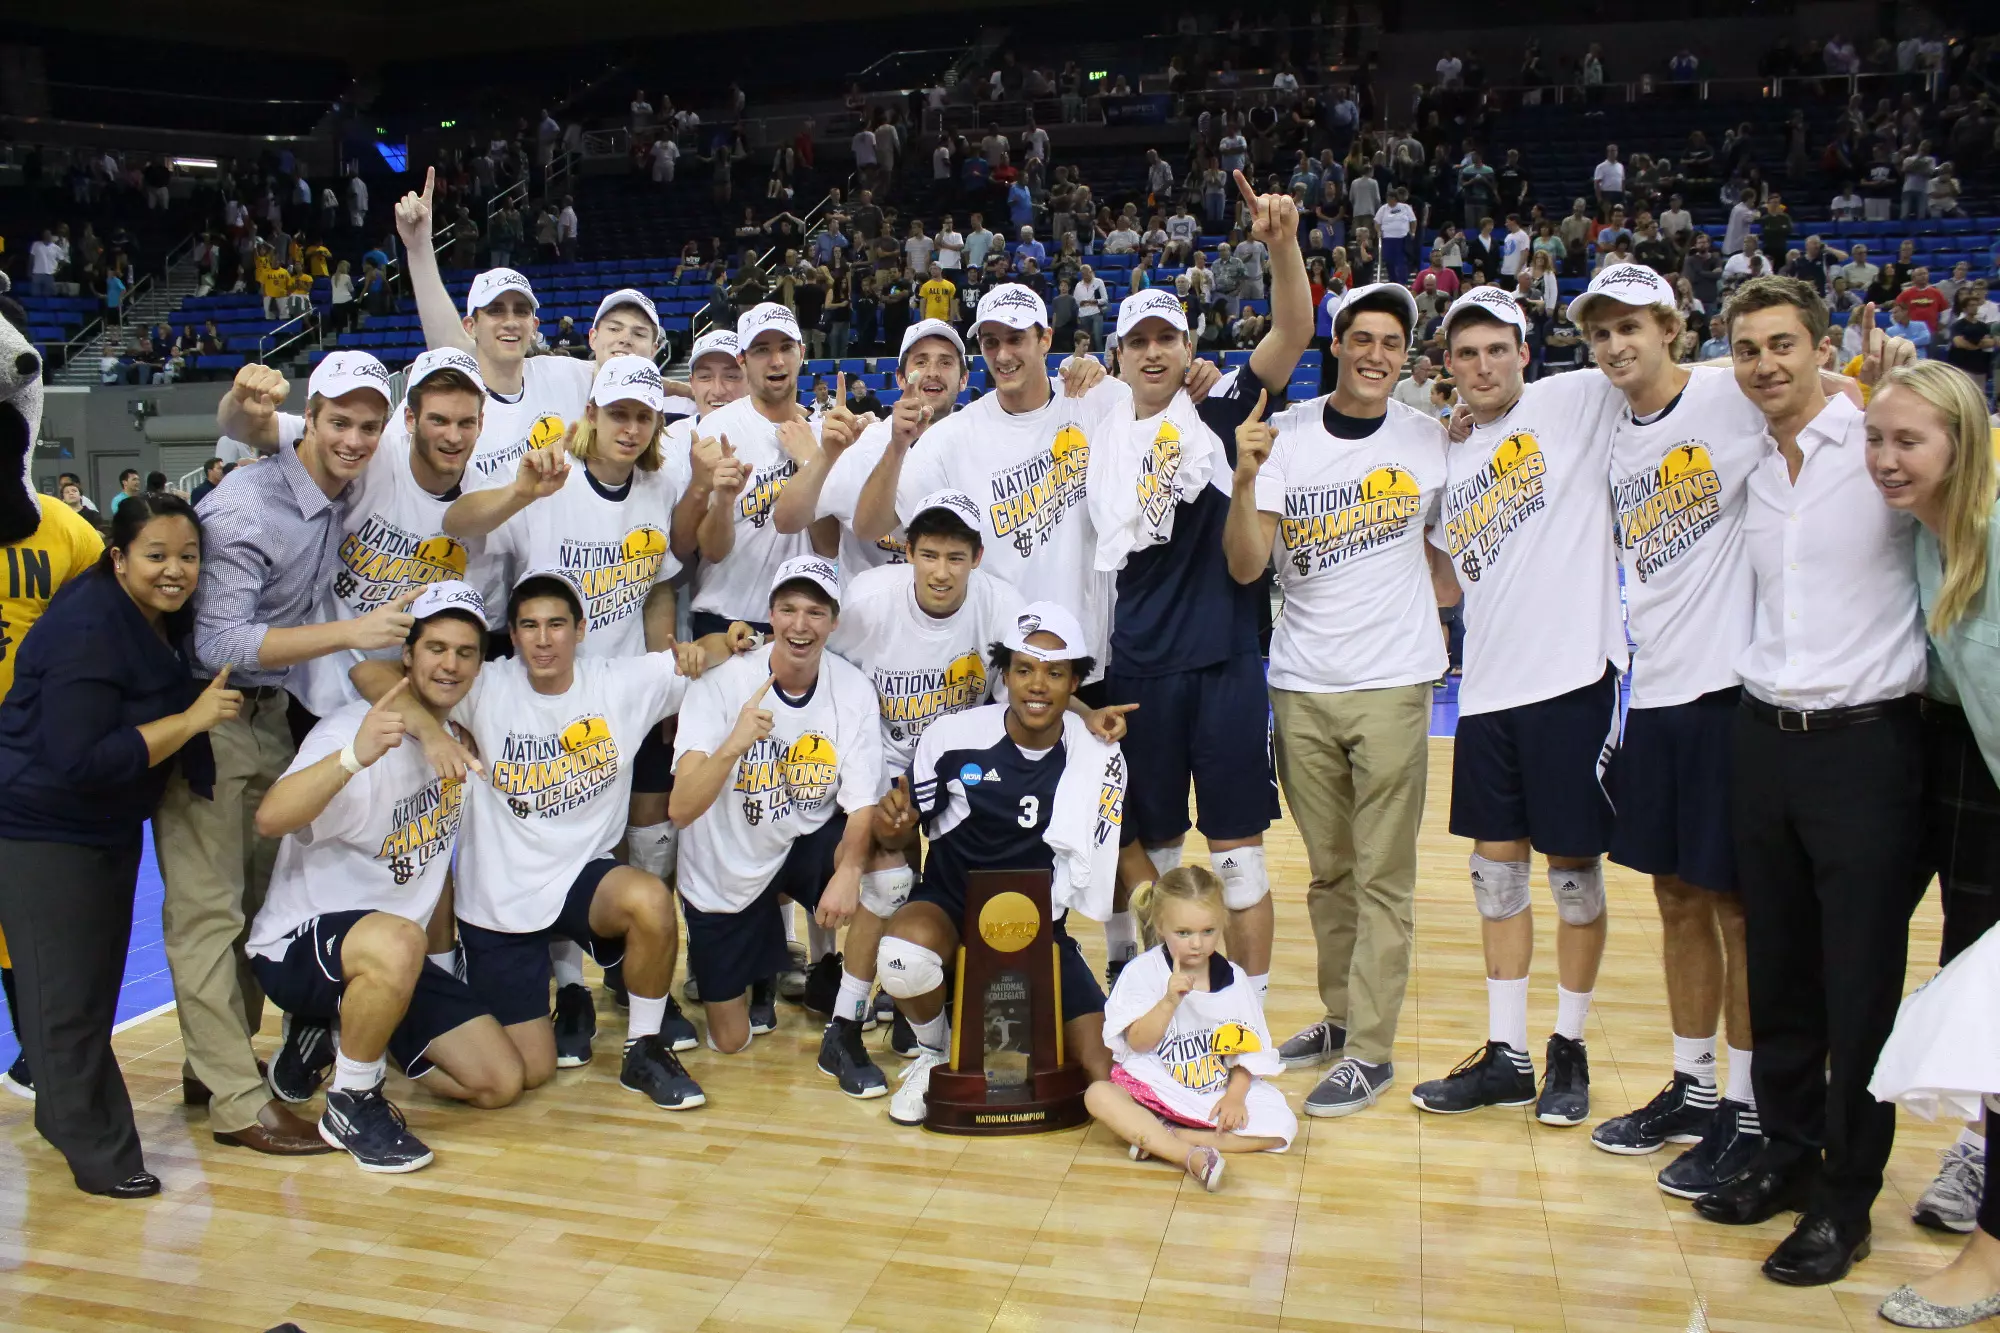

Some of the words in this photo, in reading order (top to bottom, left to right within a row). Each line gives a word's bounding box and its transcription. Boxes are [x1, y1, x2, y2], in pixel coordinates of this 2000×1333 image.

[1089, 71, 1108, 80] EXIT
[1285, 481, 1376, 517] NATIONAL
[1313, 483, 1331, 492] MEN'S
[1281, 495, 1421, 551] CHAMPIONS
[1640, 531, 1663, 561] UC
[1662, 496, 1720, 546] IRVINE
[560, 543, 634, 568] NATIONAL
[6, 547, 52, 599] IN
[360, 583, 390, 601] UC
[589, 595, 614, 619] UC
[492, 738, 619, 796] CHAMPIONS
[963, 773, 981, 781] NCAA
[536, 787, 561, 811] UC
[565, 760, 618, 799] IRVINE
[540, 775, 616, 819] ANTEATERS
[1017, 795, 1040, 828] 3
[988, 991, 1026, 1001] COLLEGIATE
[990, 982, 1025, 992] NATIONAL
[975, 1115, 1009, 1124] NATIONAL
[1010, 1111, 1045, 1122] CHAMPION
